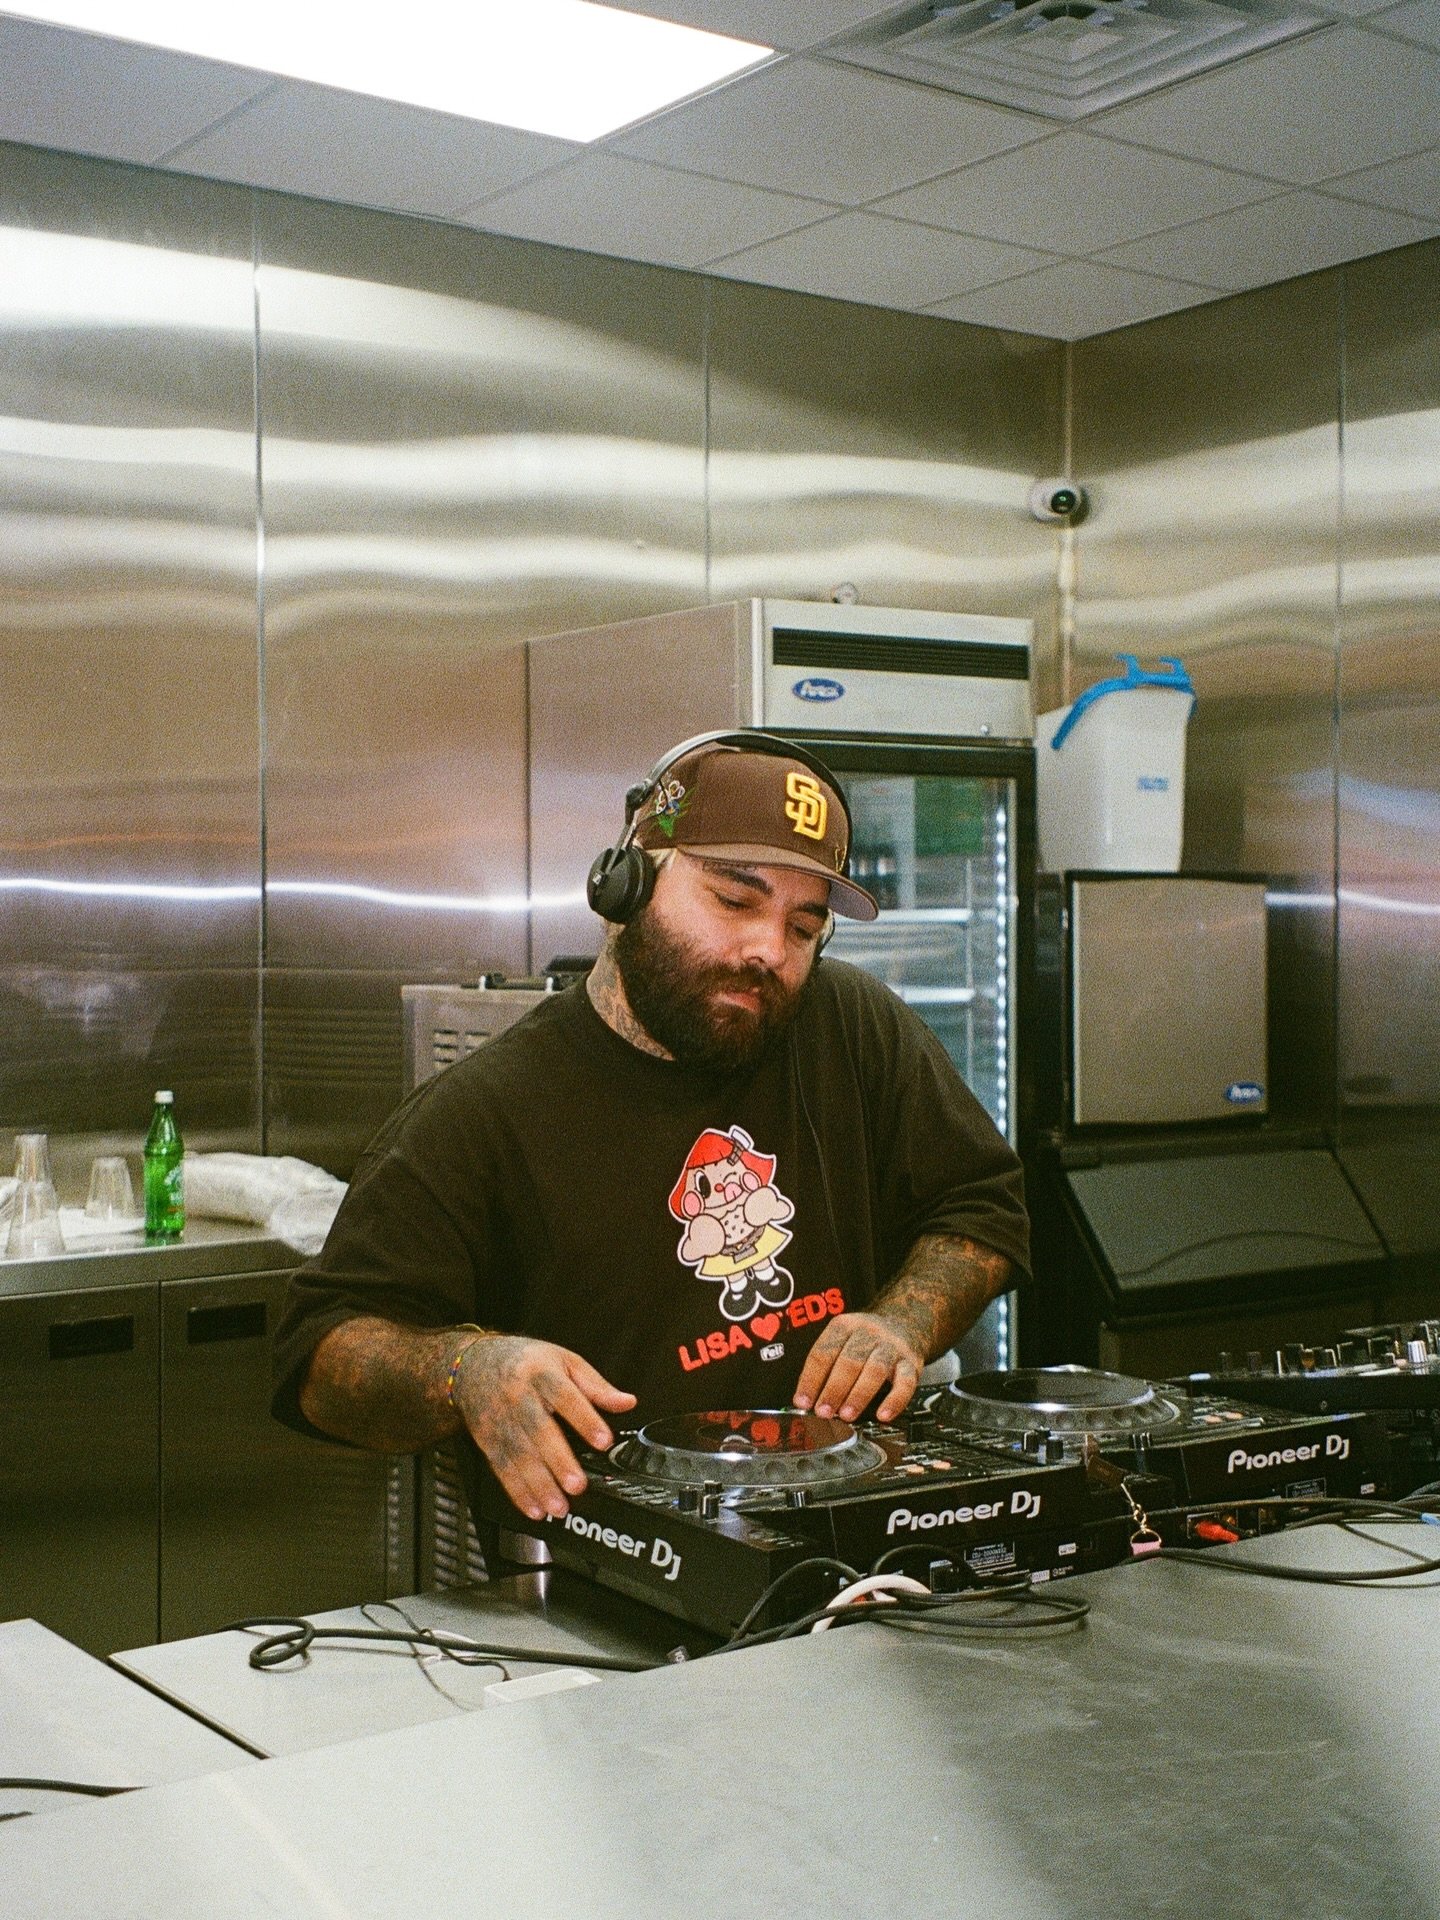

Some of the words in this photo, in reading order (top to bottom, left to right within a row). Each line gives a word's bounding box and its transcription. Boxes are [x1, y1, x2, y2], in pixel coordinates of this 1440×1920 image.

[785, 772, 827, 840] SD
[678, 1325, 753, 1372] LISA
[1227, 1443, 1321, 1474] Pioneer
[546, 1512, 646, 1558] ioneer
[886, 1501, 1005, 1535] Pioneer
